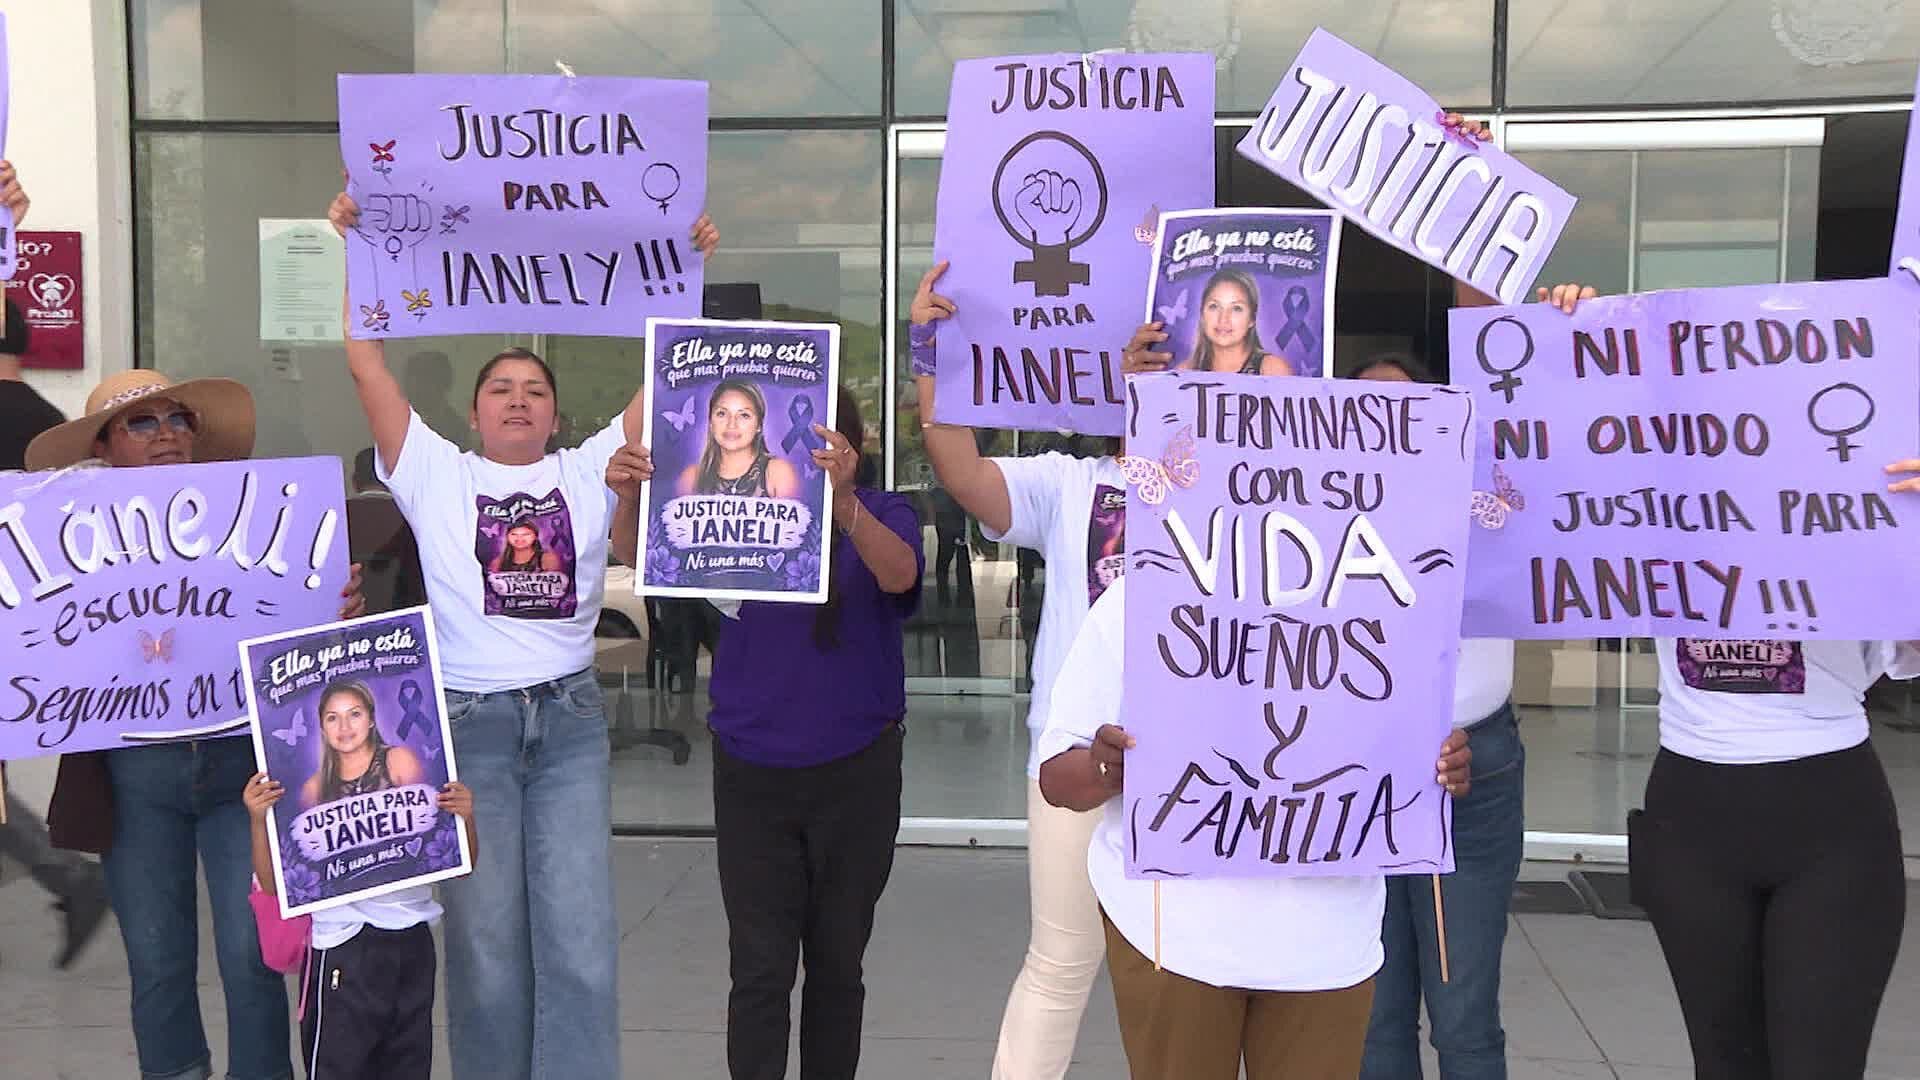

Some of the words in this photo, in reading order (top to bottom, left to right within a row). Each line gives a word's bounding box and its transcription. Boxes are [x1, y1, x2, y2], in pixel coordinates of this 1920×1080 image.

[991, 60, 1185, 114] JUSTICIA
[440, 104, 646, 160] JUSTICIA
[504, 181, 609, 210] PARA
[1257, 66, 1549, 304] JUSTICIA
[1172, 228, 1214, 262] Ella
[1214, 230, 1243, 256] ya
[1245, 230, 1269, 247] no
[1272, 227, 1317, 252] está
[1013, 303, 1095, 331] PARA
[672, 338, 716, 369] Ella
[715, 342, 746, 367] ya
[749, 342, 773, 359] no
[776, 340, 817, 364] está
[1573, 327, 1641, 378] NI
[1668, 317, 1874, 376] PERDON
[667, 368, 691, 388] que
[694, 364, 719, 378] mas
[722, 360, 769, 380] pruebas
[772, 363, 817, 382] quieren
[971, 342, 1126, 406] IANEL
[1179, 382, 1430, 454] TERMINASTE
[1493, 418, 1549, 460] NI
[1587, 412, 1770, 458] OLVIDO
[674, 500, 748, 520] JUSTICIA
[755, 501, 799, 524] PARA
[692, 518, 781, 546] IANELI
[1552, 487, 1756, 533] JUSTICIA
[1778, 489, 1898, 536] PARA
[686, 551, 706, 571] Ni
[708, 555, 736, 567] una
[738, 552, 765, 569] más
[1162, 505, 1417, 608] VIDA
[53, 576, 237, 646] escucha
[269, 648, 315, 685] Ella
[317, 644, 346, 672] ya
[348, 637, 371, 657] no
[375, 627, 416, 650] está
[1157, 602, 1393, 701] SUEÑOS
[1704, 643, 1772, 662] IANELI
[269, 683, 293, 703] que
[296, 670, 322, 688] mas
[325, 658, 371, 683] pruebas
[374, 652, 419, 673] quieren
[0, 675, 171, 748] Seguimos
[187, 672, 223, 720] en
[1263, 701, 1308, 780] Y
[304, 797, 379, 834] JUSTICIA
[383, 788, 429, 811] PARA
[325, 810, 414, 852] IANELI
[1148, 761, 1422, 864] FAMILIA
[326, 857, 347, 881] Ni
[348, 853, 377, 870] una
[378, 843, 405, 863] más
